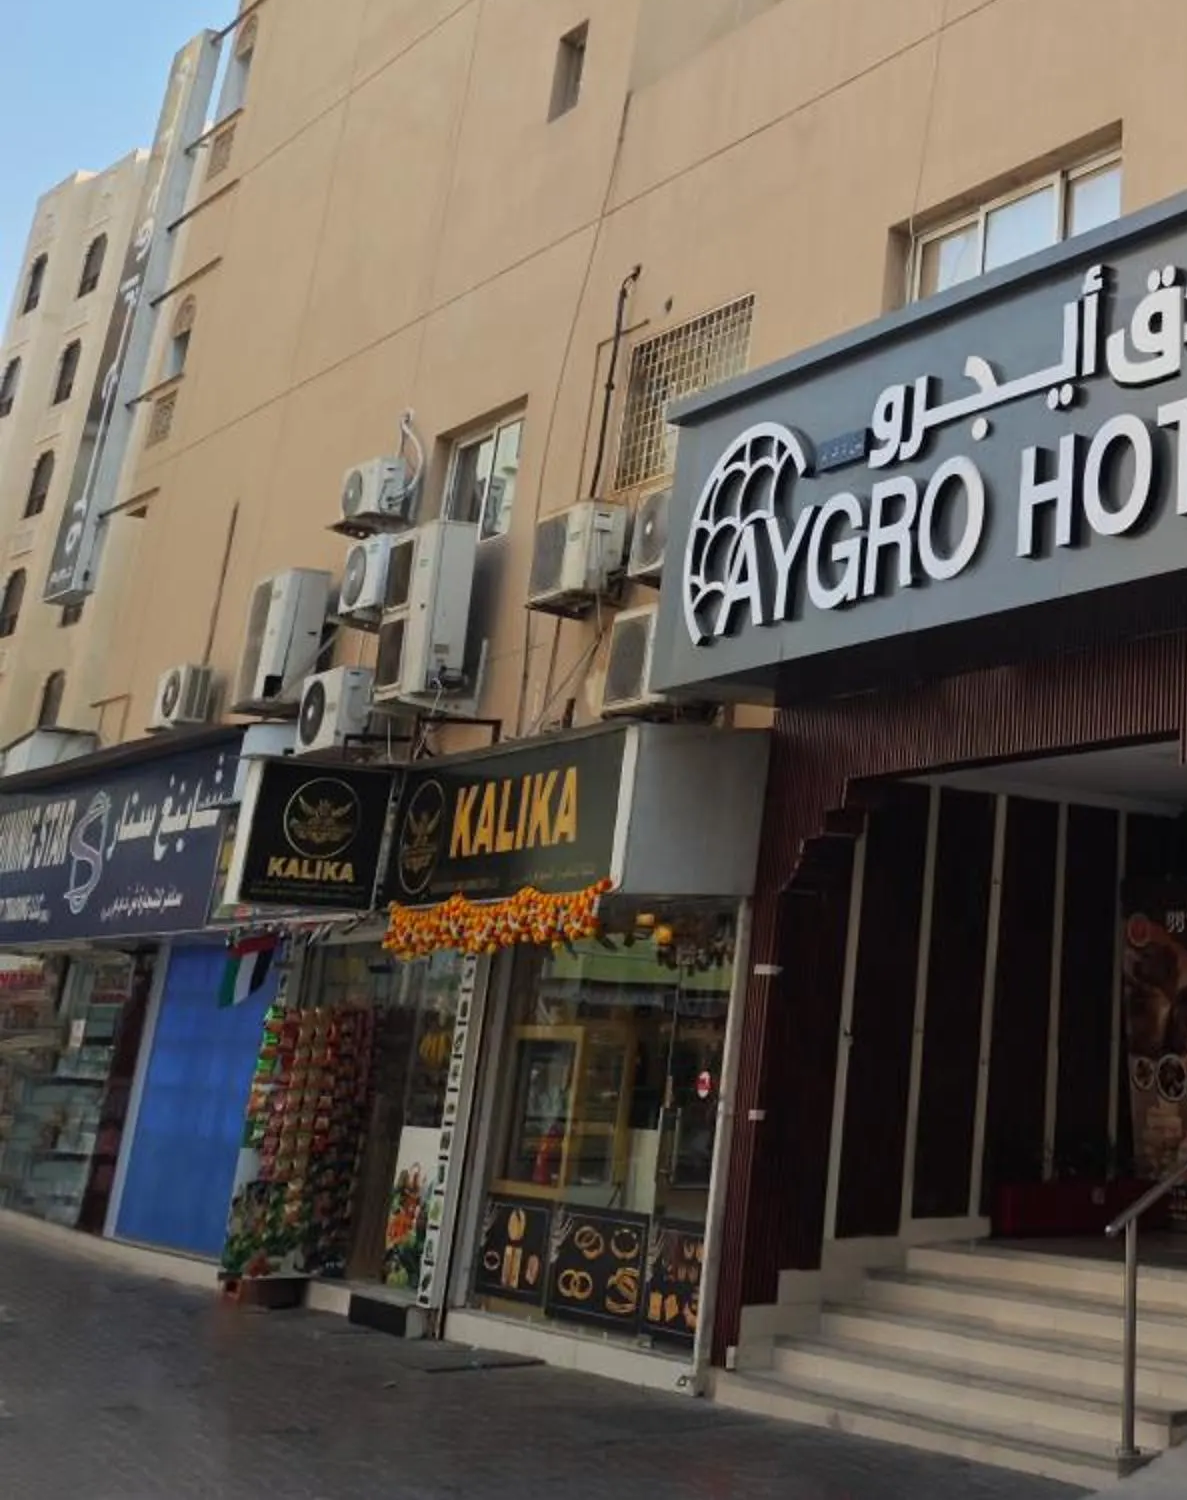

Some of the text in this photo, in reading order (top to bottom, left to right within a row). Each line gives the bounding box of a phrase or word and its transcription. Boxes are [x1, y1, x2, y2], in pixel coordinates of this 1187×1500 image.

[713, 455, 986, 636] AYGRO
[33, 798, 77, 869] STAR
[449, 765, 577, 860] KALIKA
[266, 855, 356, 884] KALIKA
